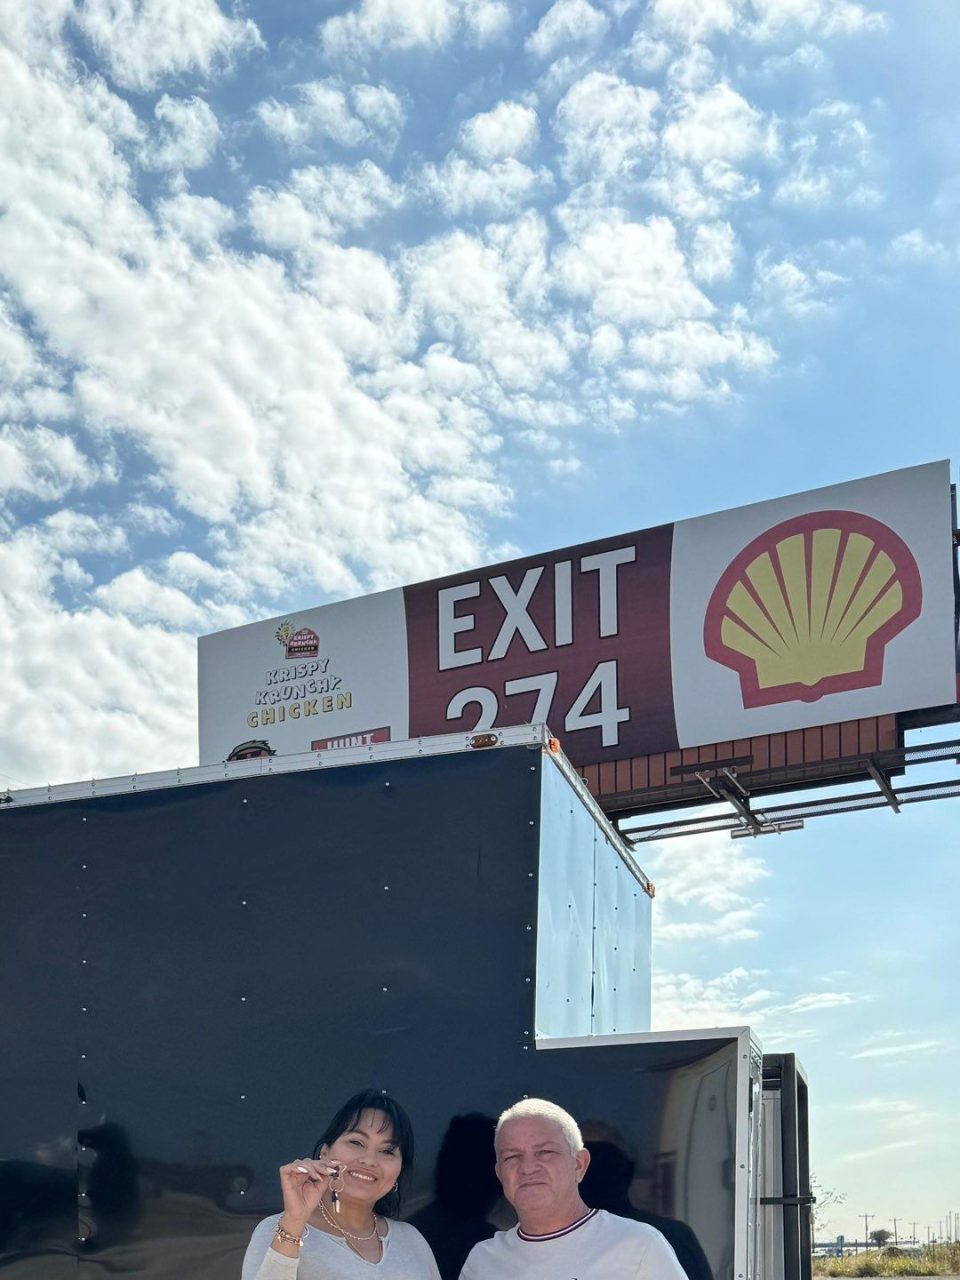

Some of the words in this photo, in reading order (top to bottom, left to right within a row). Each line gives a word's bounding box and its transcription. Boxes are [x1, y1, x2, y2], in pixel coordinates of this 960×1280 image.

[438, 545, 637, 671] EXIT
[266, 658, 330, 685] KRISPY
[255, 675, 343, 705] KRUNCHY
[446, 659, 630, 748] 274
[247, 692, 352, 728] CHICKEN
